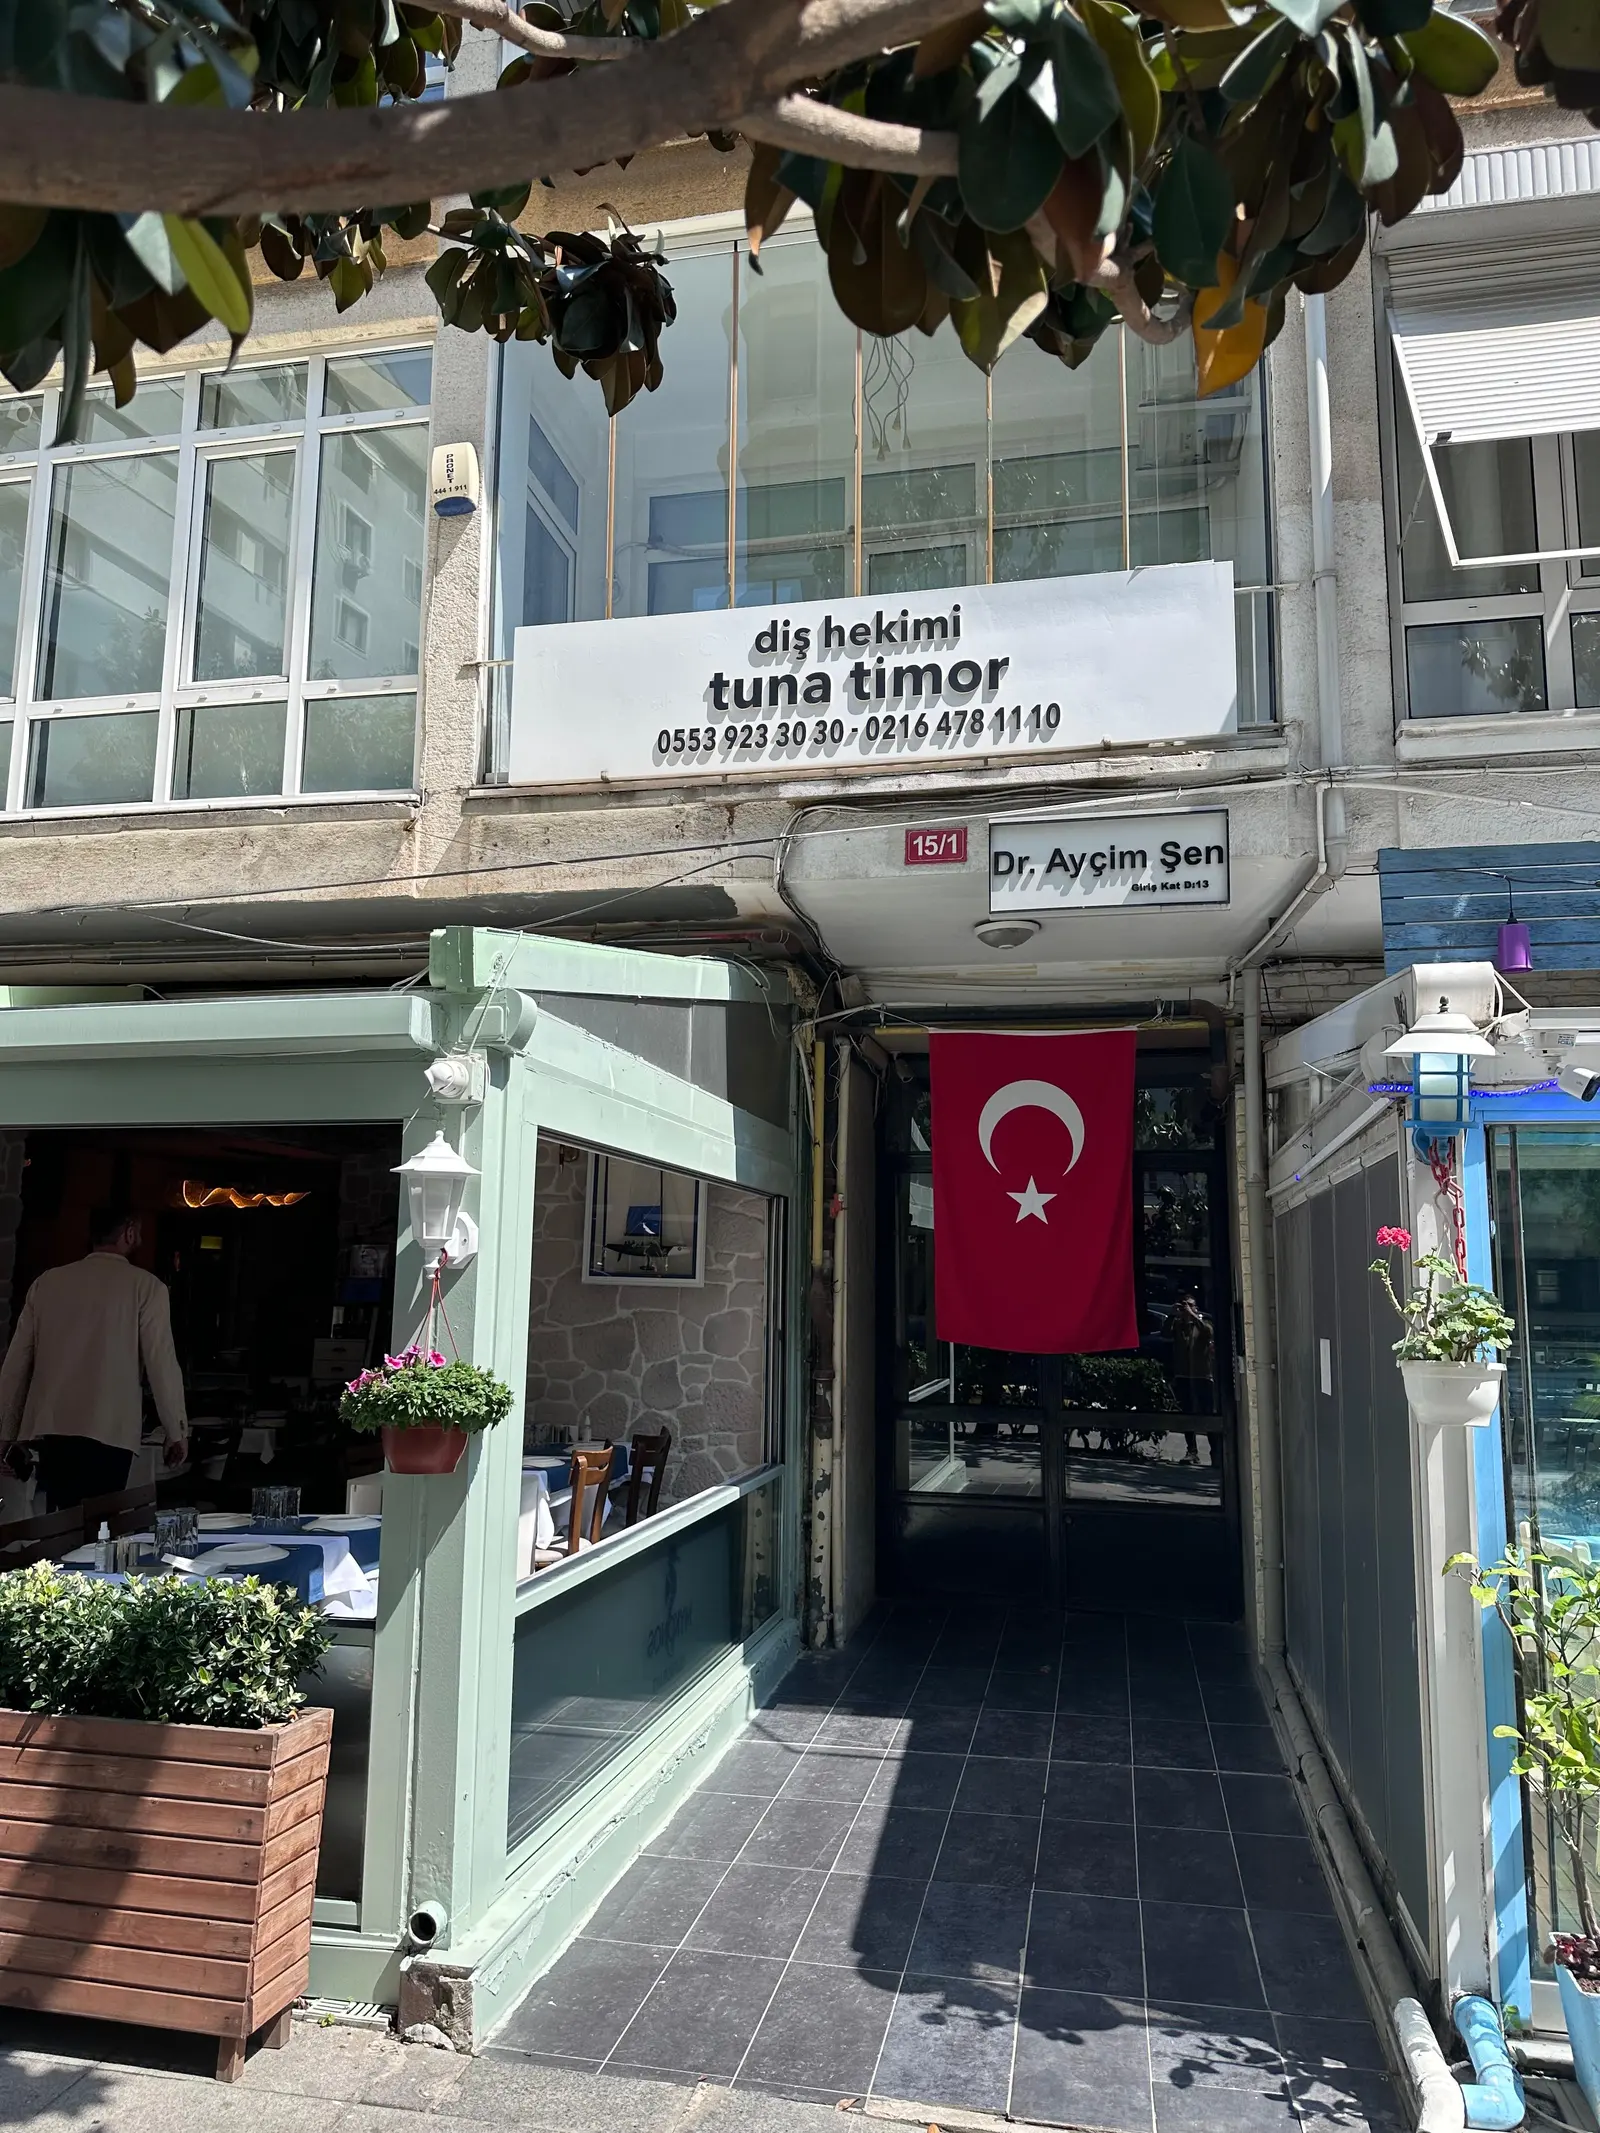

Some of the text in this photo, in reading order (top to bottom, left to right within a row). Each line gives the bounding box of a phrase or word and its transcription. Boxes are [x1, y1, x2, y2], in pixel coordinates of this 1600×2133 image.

[446, 453, 454, 484] PRONET
[434, 487, 447, 495] 444
[755, 604, 961, 660] diş hekimi
[709, 656, 1010, 711] tuna timor
[657, 726, 717, 754] 0553
[724, 723, 769, 750] 923
[775, 721, 807, 747] 30
[813, 718, 844, 745] 30
[866, 712, 929, 741] 0216
[936, 708, 985, 735] 478
[912, 832, 958, 857] 15/1
[993, 841, 1224, 878] Dr. Ayçim Şen
[1131, 879, 1210, 893] Giriş Kat D:13
